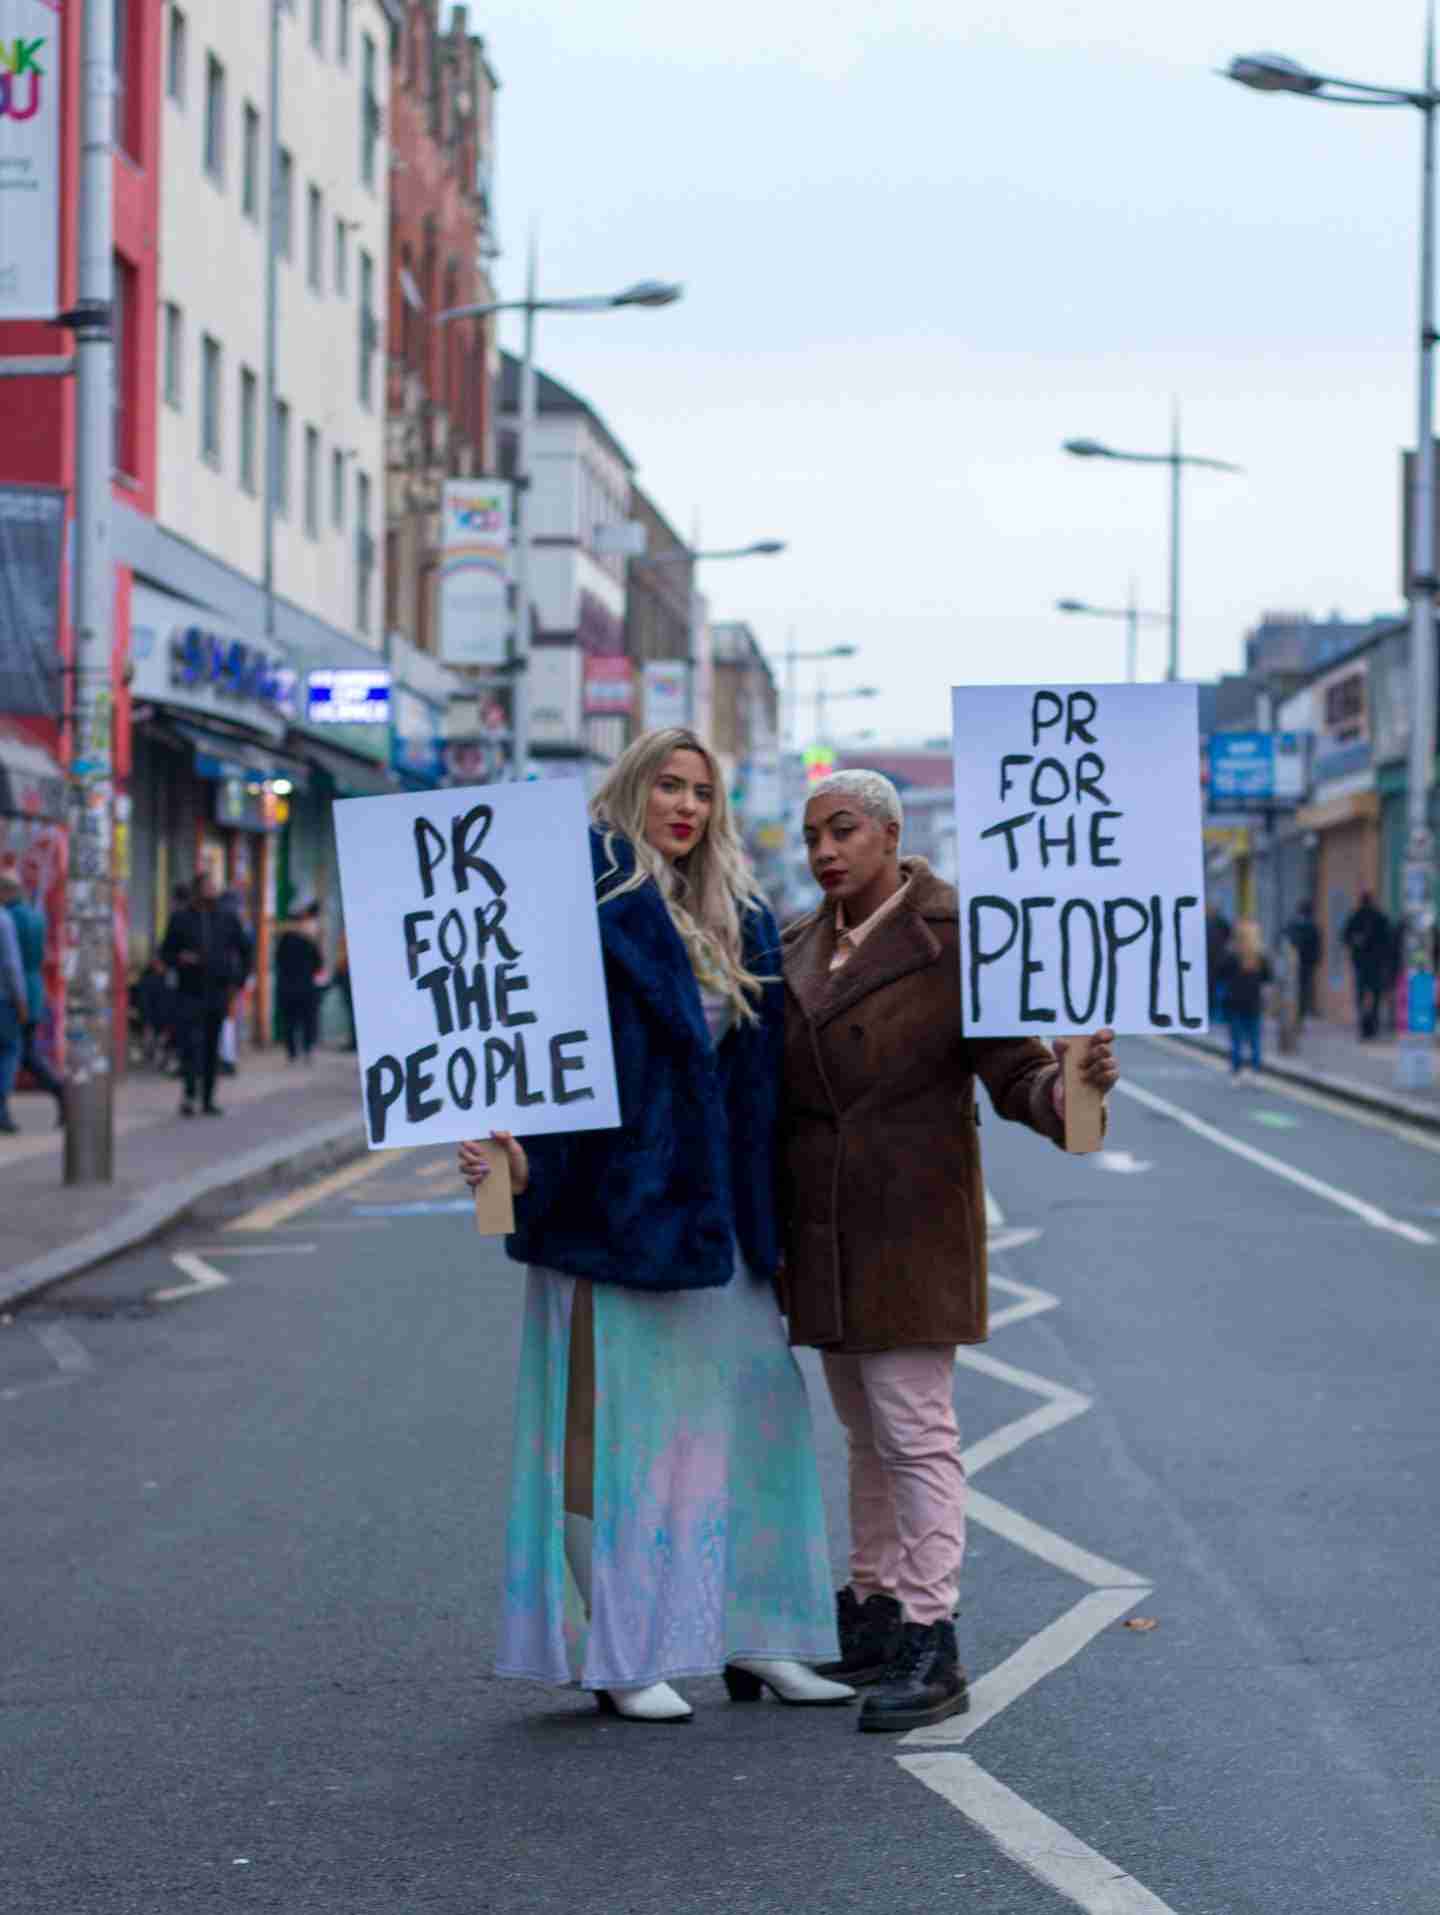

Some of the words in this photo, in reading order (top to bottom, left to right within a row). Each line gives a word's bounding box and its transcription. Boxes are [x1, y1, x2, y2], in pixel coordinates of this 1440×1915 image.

[1032, 690, 1098, 747] PR
[1001, 752, 1111, 806] FOR
[414, 804, 507, 898] PR
[980, 811, 1124, 872] THE
[404, 898, 523, 980] FOR
[969, 895, 1203, 1029] PEOPLE
[416, 962, 538, 1036] THE
[366, 1031, 595, 1144] PEOPLE
